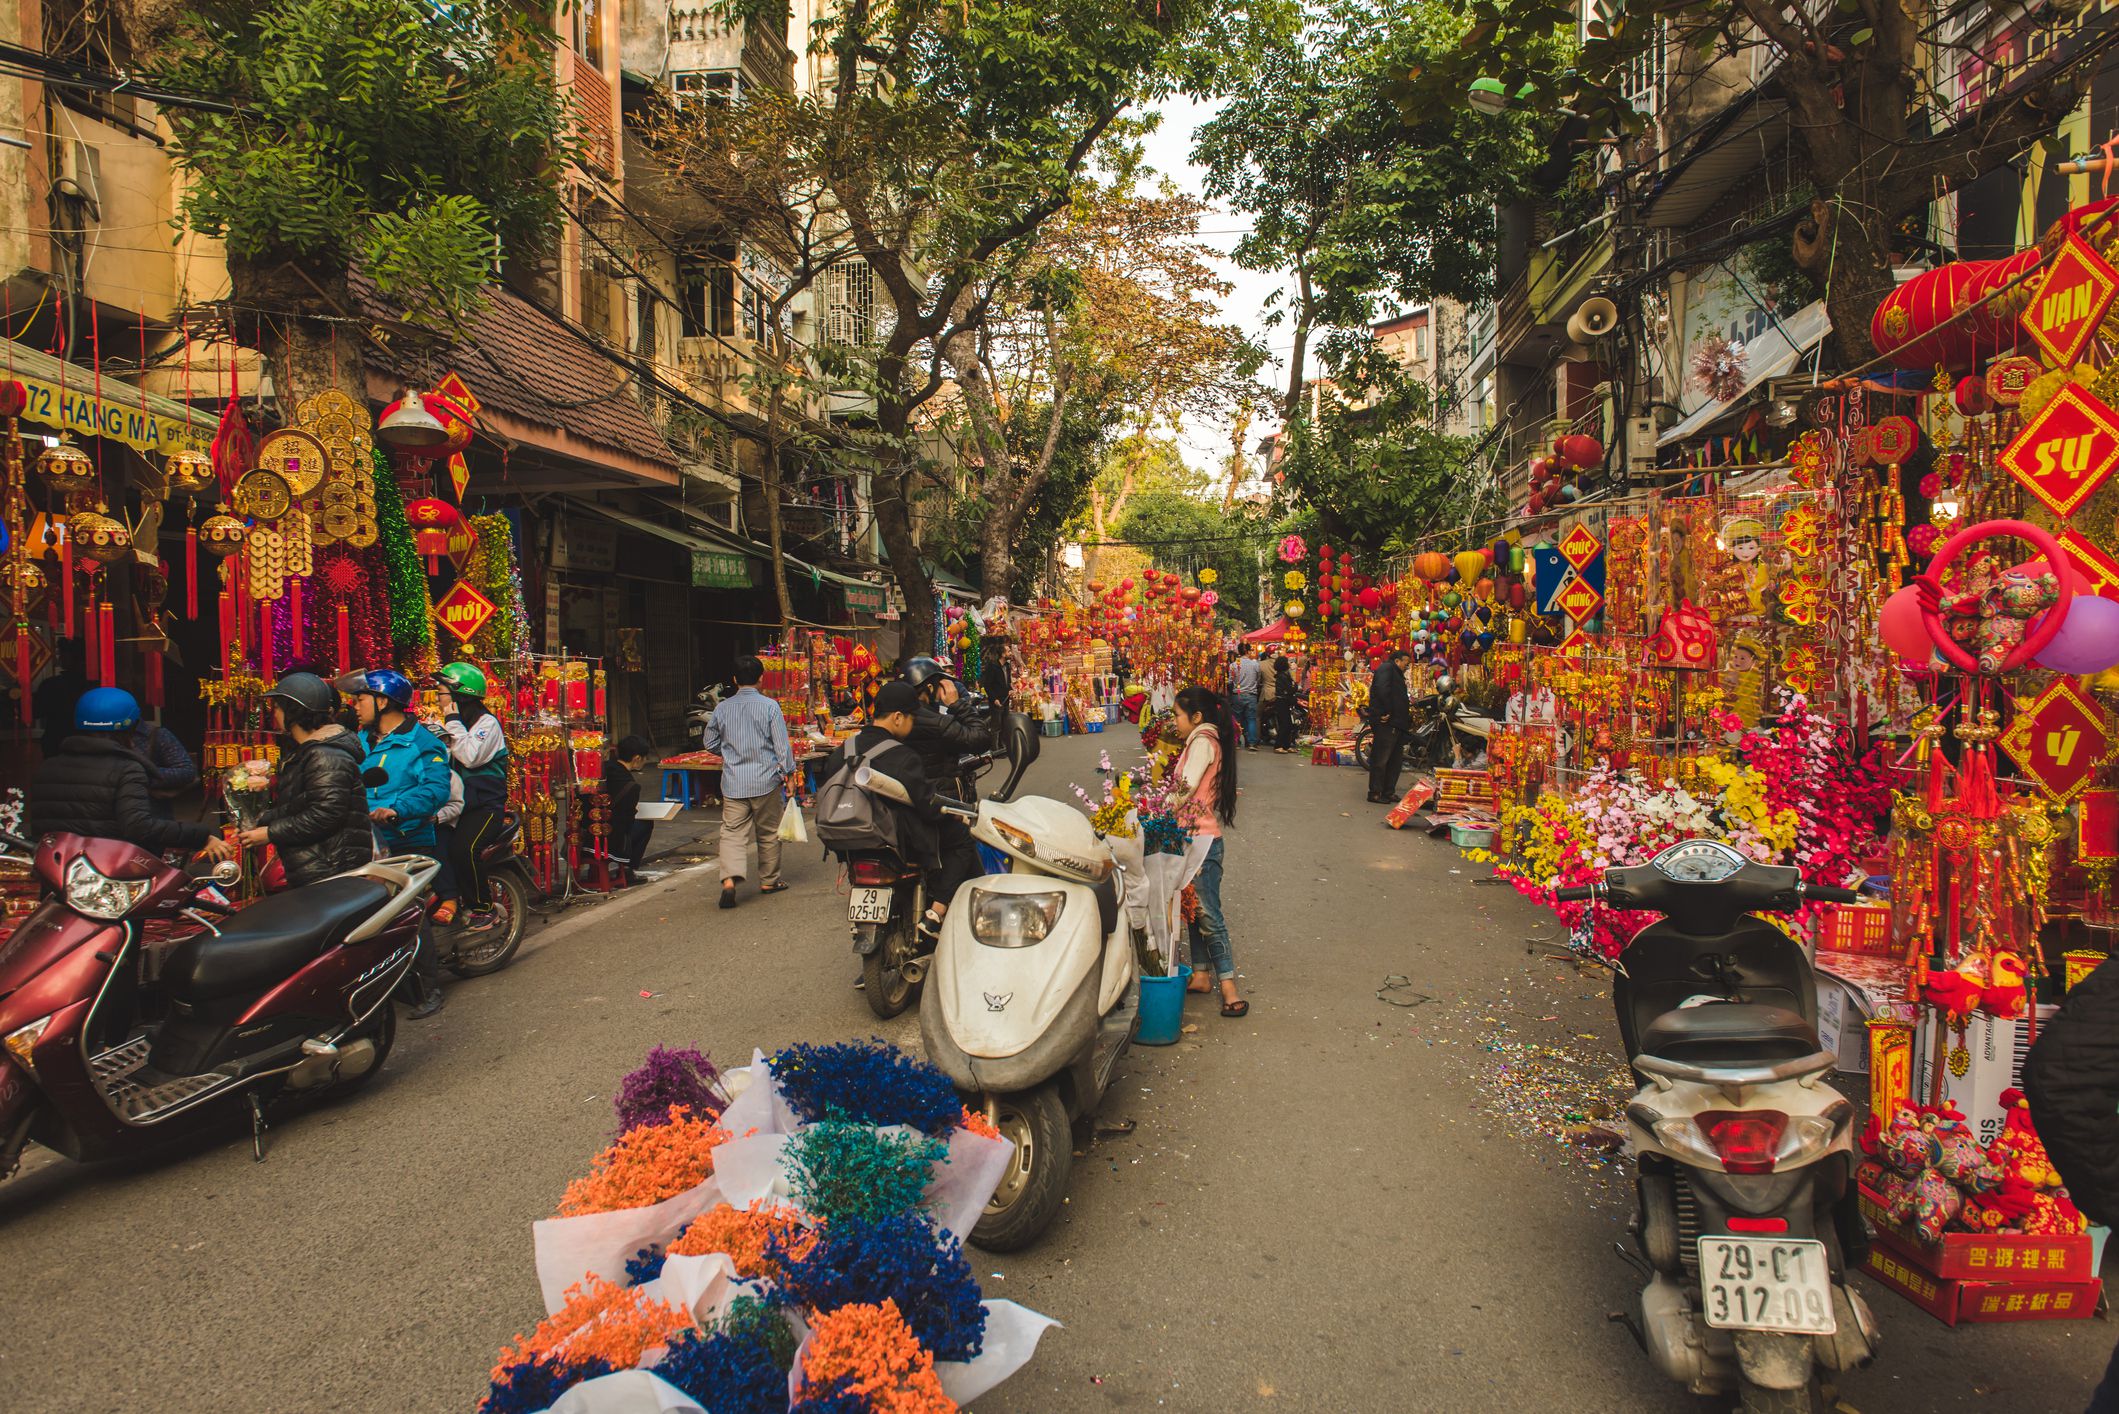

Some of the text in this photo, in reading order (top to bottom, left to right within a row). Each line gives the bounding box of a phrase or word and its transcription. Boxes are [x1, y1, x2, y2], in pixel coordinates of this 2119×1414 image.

[2042, 279, 2093, 333] VẠN
[27, 384, 52, 417] 72
[59, 392, 123, 435] HÀNG
[2033, 427, 2101, 479] SỰ
[1566, 538, 1591, 556] CHÚC
[446, 600, 482, 622] MỚI
[1566, 591, 1591, 607] MỪNG
[2046, 724, 2082, 767] Ý
[862, 889, 878, 904] 29
[1984, 1017, 1994, 1061] ADVANTAG
[1717, 1243, 1808, 1284] 29-C1
[1711, 1284, 1826, 1327] 312.09
